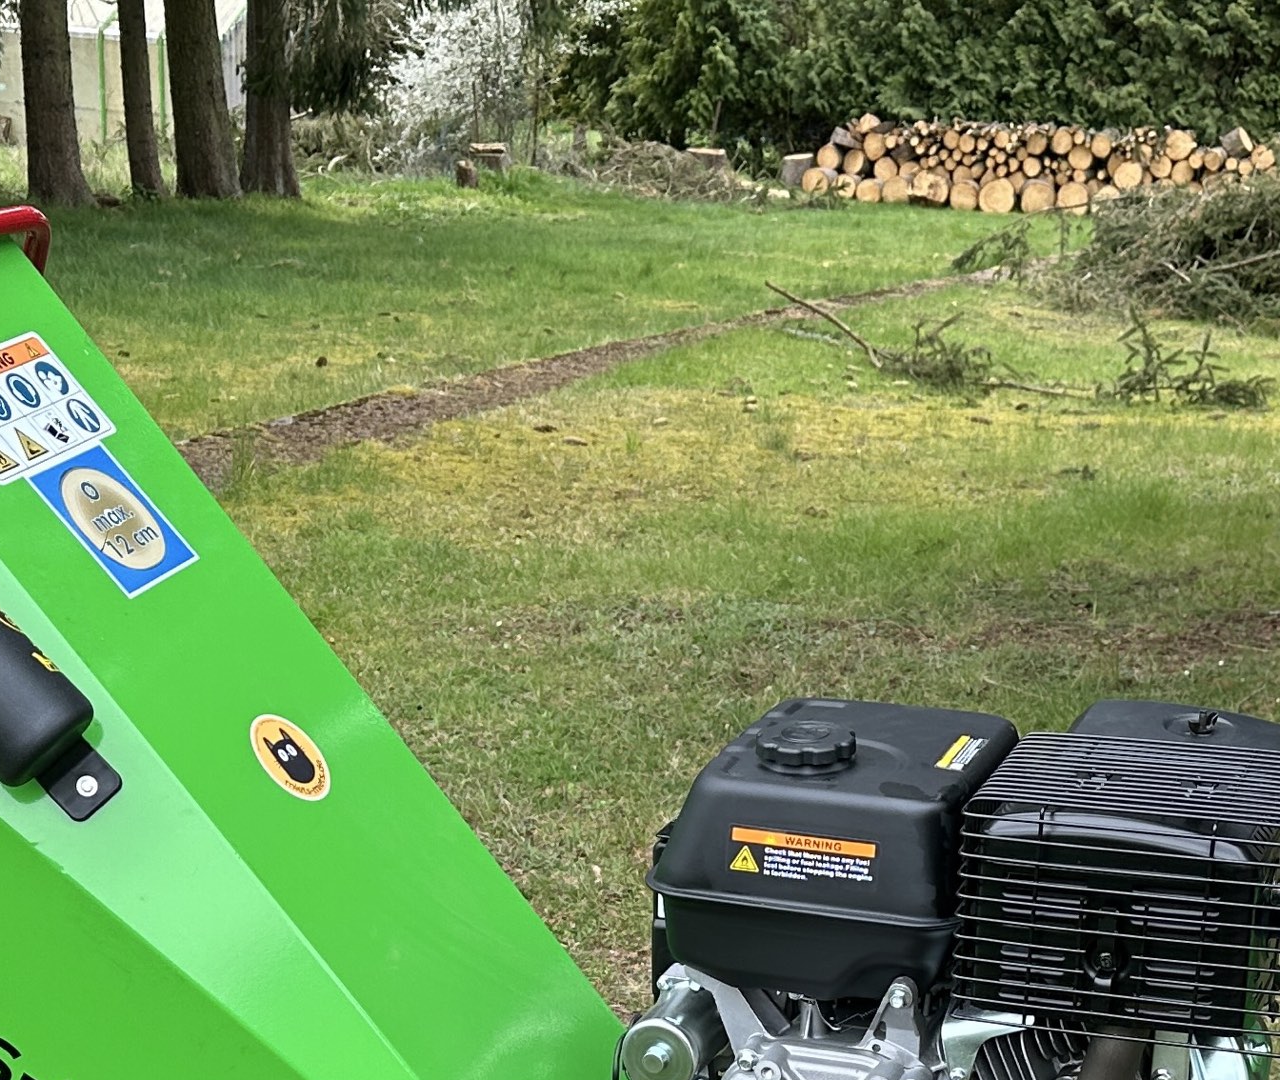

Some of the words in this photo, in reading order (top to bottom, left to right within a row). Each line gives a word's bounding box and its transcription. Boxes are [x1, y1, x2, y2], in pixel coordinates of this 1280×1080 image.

[92, 505, 134, 532] max.
[106, 535, 134, 558] 12
[133, 526, 159, 546] cm
[764, 847, 787, 856] Check
[785, 836, 842, 851] WARNING
